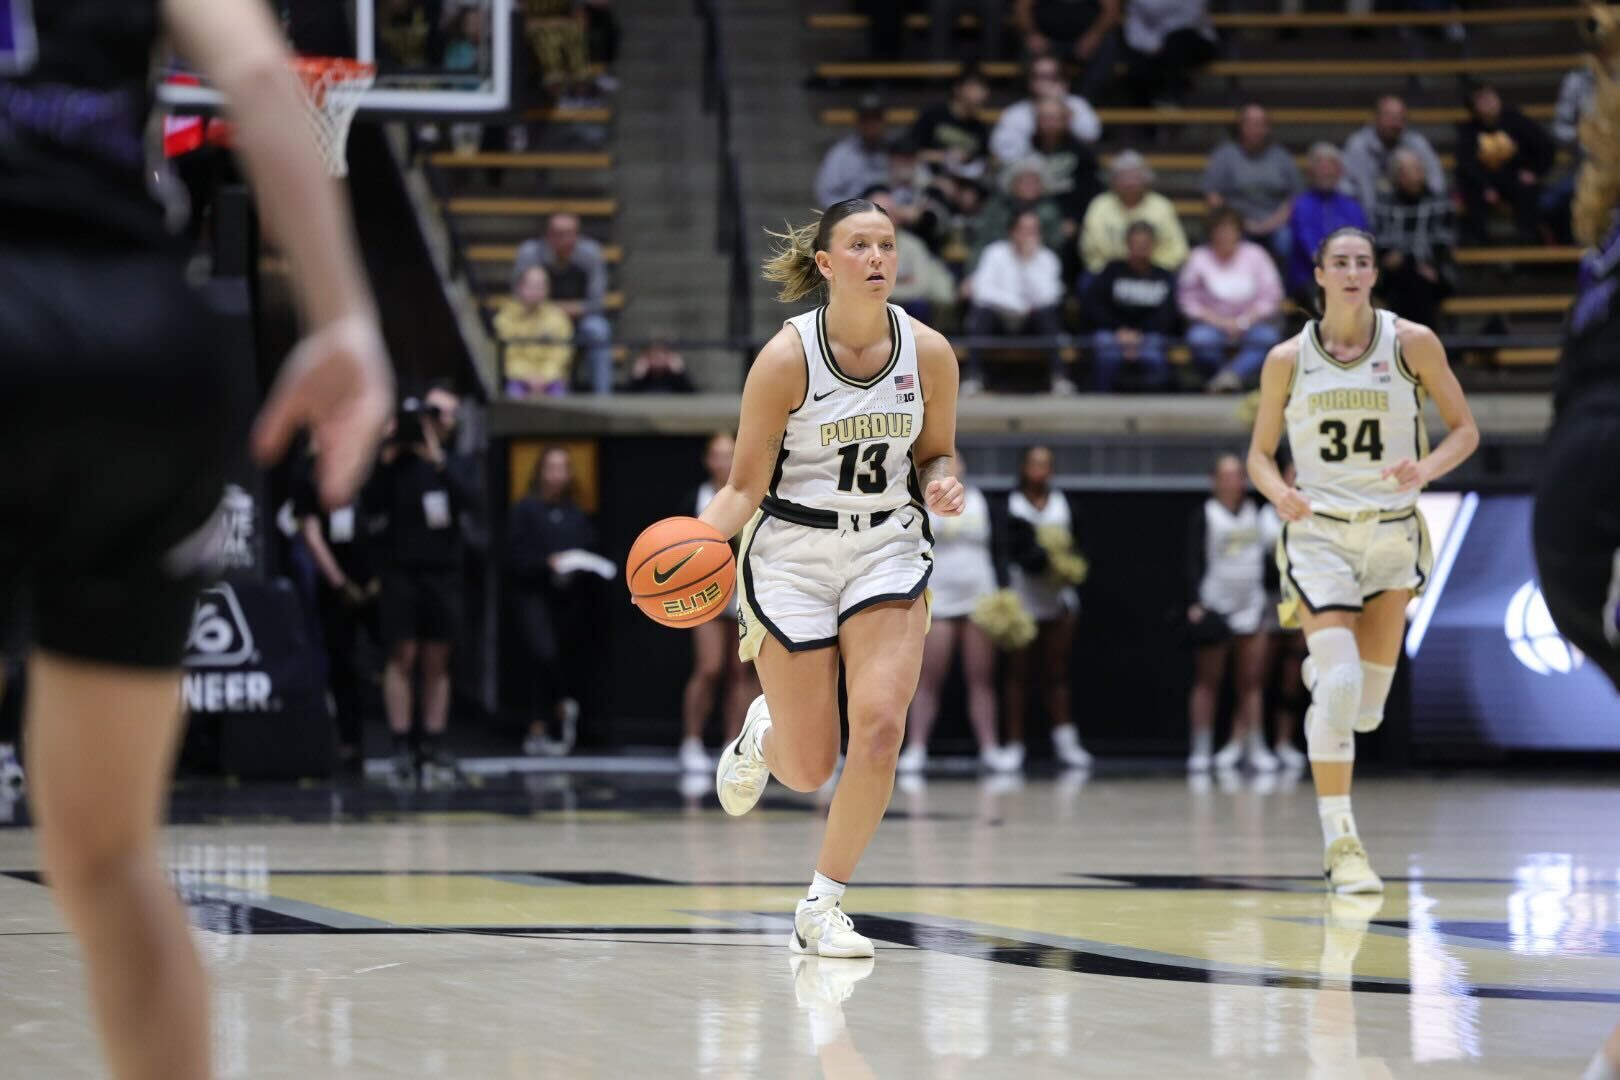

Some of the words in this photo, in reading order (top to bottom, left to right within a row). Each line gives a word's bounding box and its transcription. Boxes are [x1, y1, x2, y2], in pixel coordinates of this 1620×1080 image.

[1307, 388, 1390, 415] PURDUE
[820, 412, 912, 446] PURDUE
[1319, 418, 1384, 462] 34
[837, 442, 889, 494] 13
[662, 581, 722, 614] ELITE
[182, 671, 272, 711] NEER
